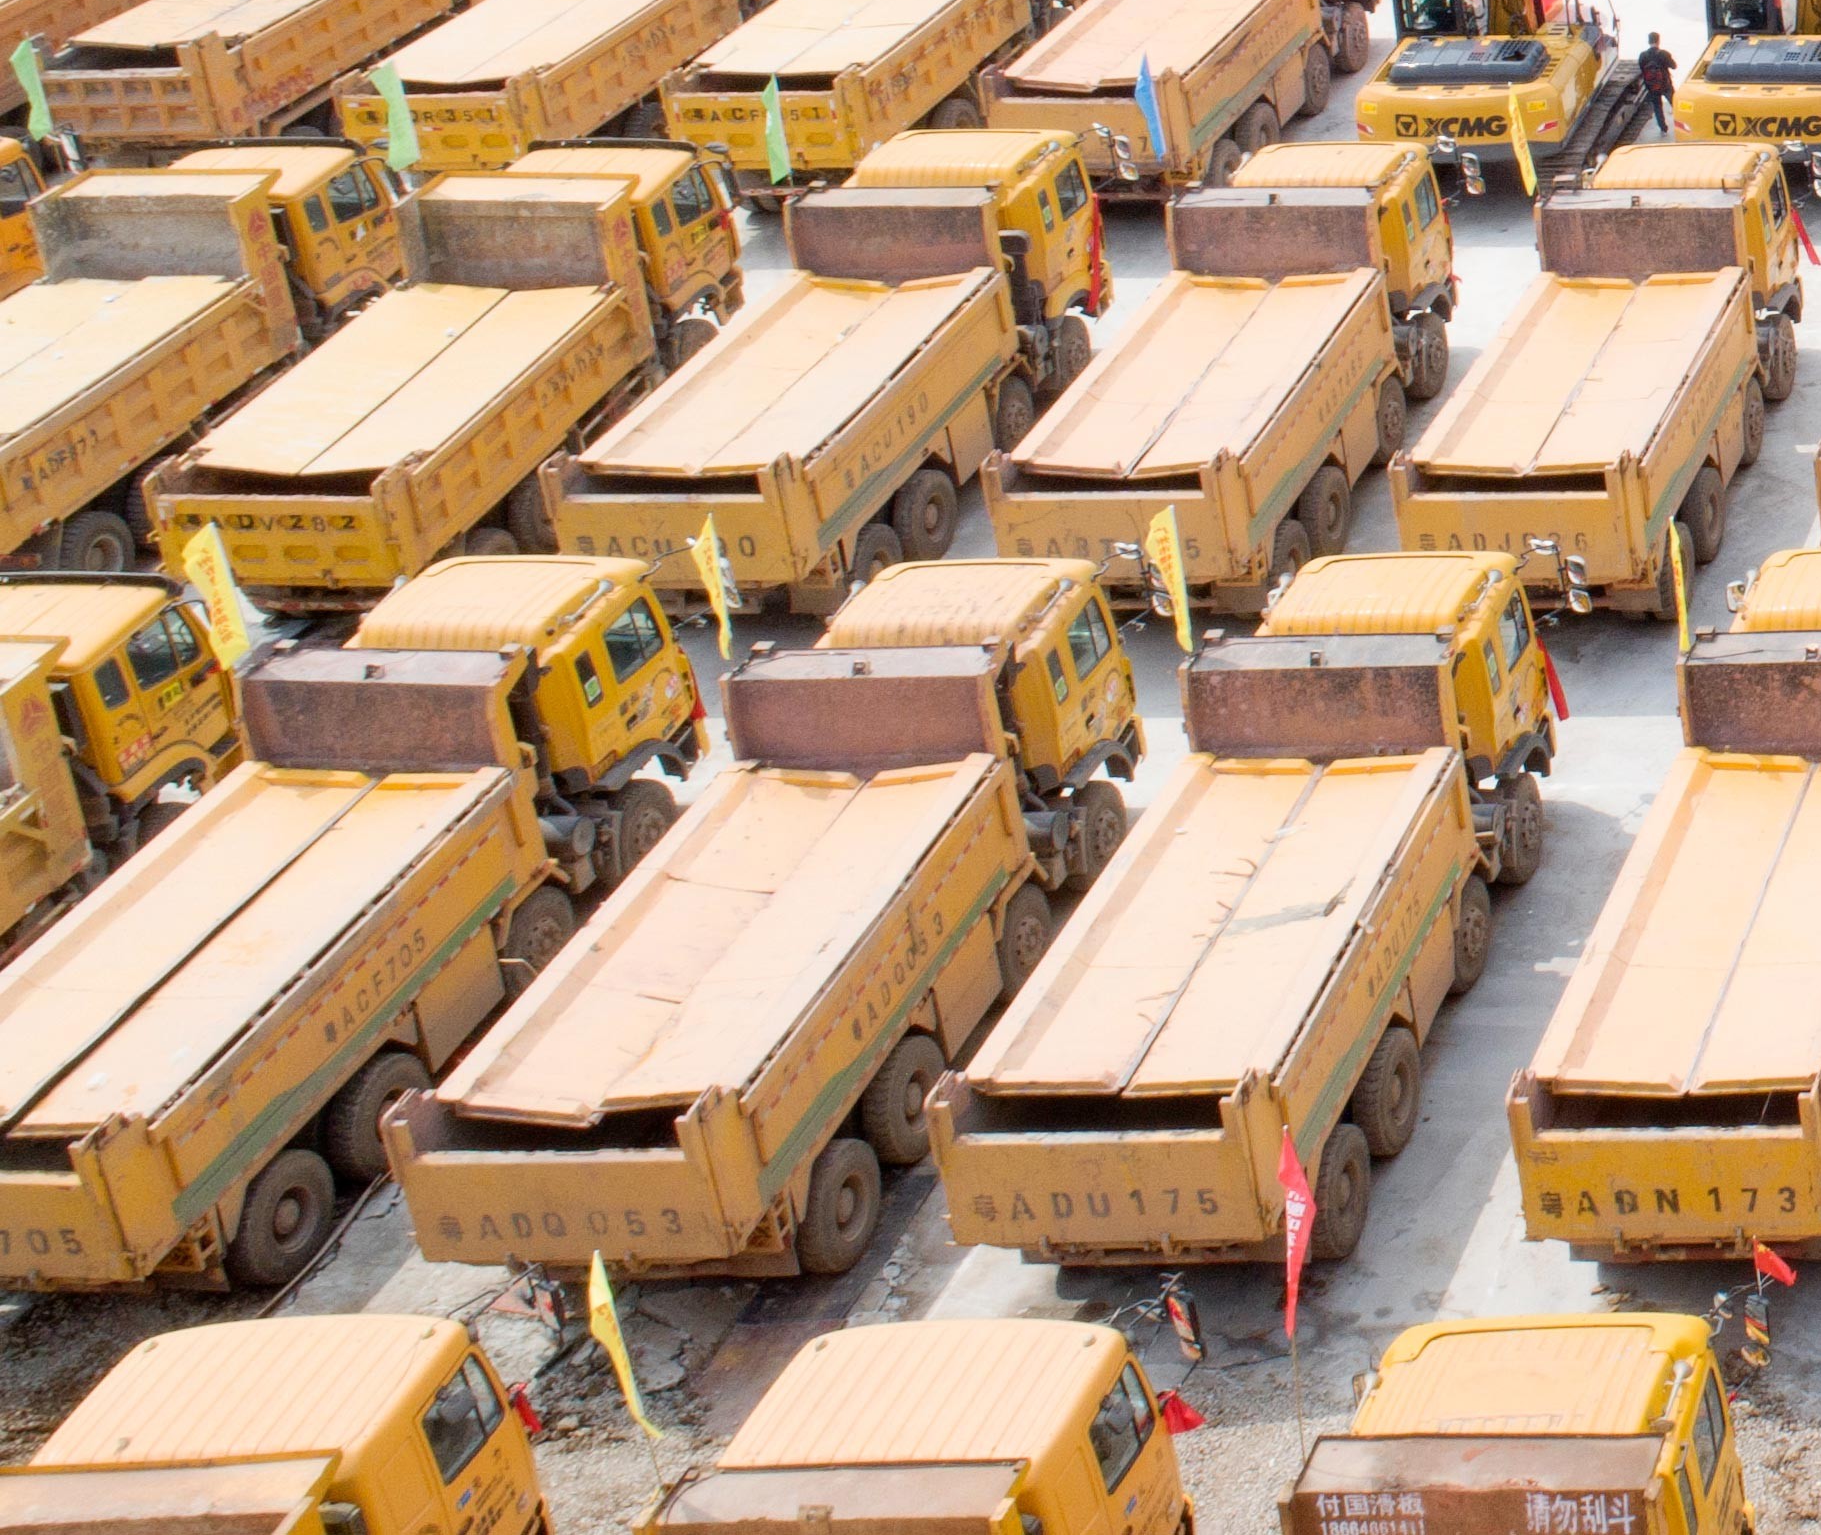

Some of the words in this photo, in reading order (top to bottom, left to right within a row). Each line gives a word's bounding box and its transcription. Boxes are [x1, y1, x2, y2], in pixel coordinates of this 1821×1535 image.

[1423, 116, 1508, 136] XCMG
[576, 533, 755, 560] 粤ACU90
[971, 1185, 1221, 1223] 粤ADU175
[1538, 1186, 1799, 1218] 粤ADN173
[1525, 1492, 1637, 1535] 请勿刮斗
